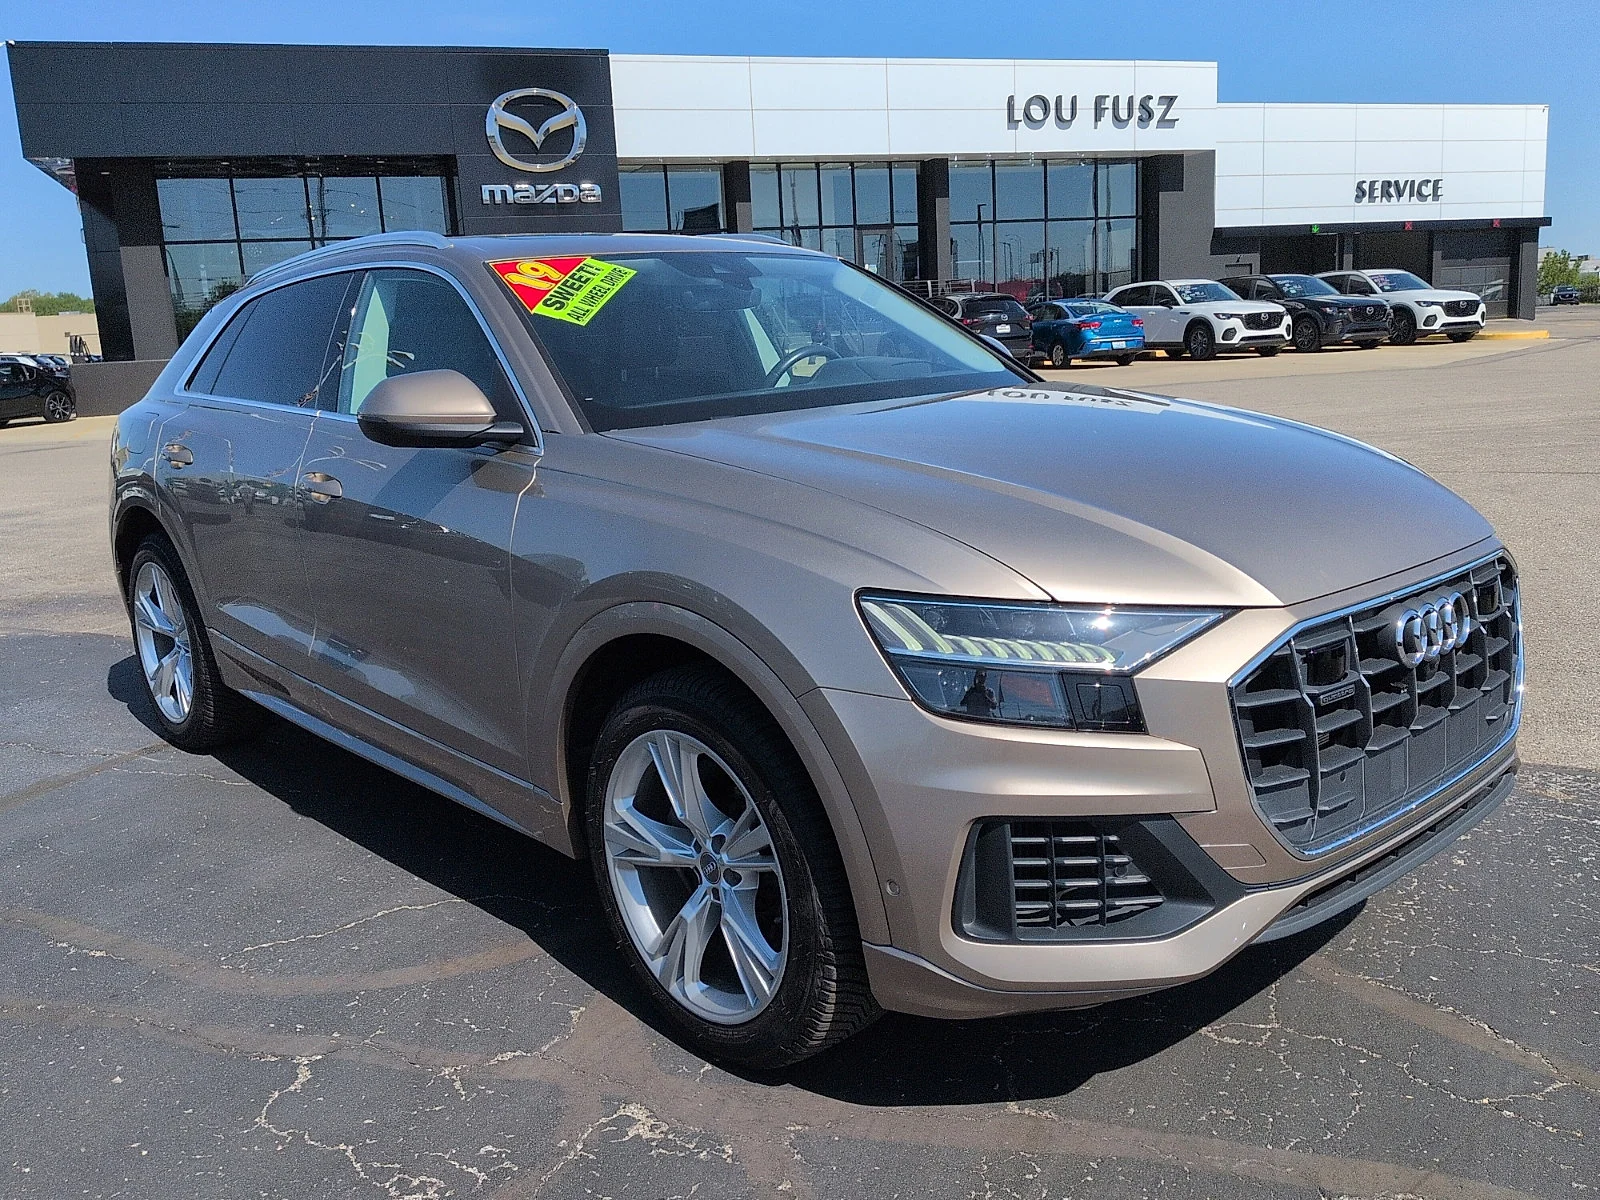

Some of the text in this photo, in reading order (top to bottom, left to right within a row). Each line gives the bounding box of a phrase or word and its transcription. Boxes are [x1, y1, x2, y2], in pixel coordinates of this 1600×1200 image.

[1007, 95, 1179, 125] LOU FUSZ
[1355, 179, 1443, 200] SERVICE
[504, 261, 566, 290] 19
[542, 263, 603, 311] SWEET!
[566, 267, 628, 322] ALL WHEEL DRIVE
